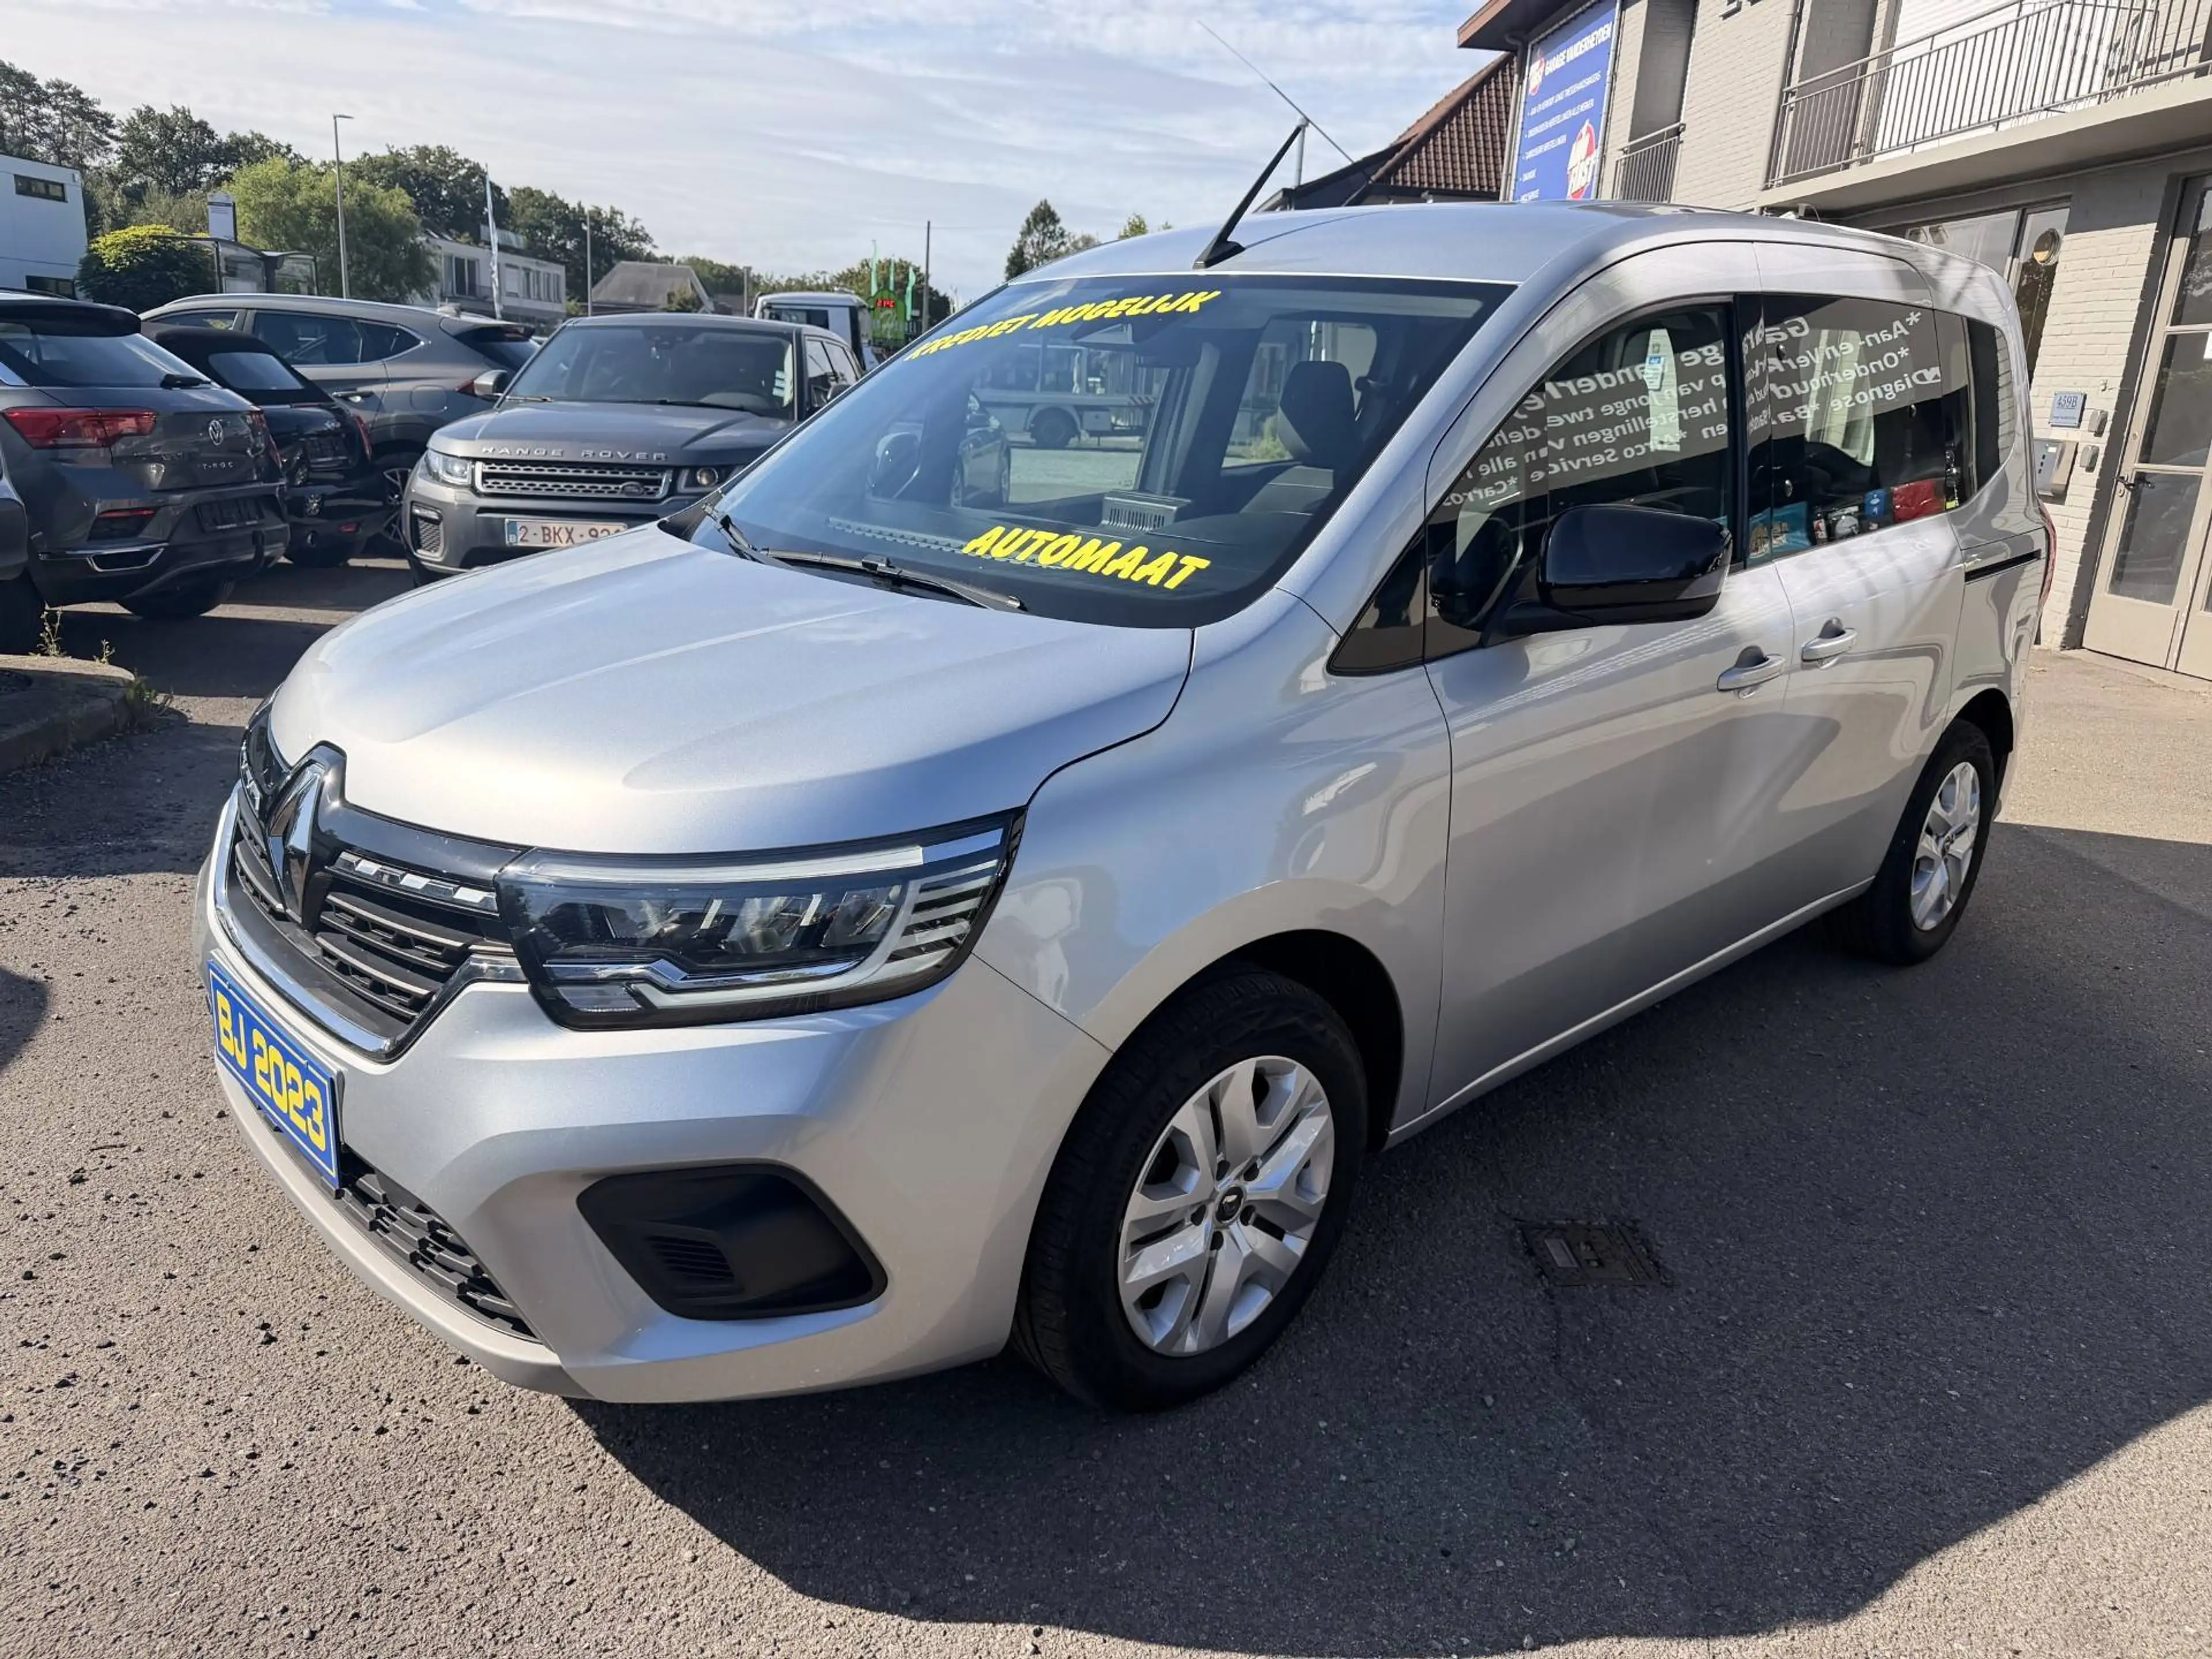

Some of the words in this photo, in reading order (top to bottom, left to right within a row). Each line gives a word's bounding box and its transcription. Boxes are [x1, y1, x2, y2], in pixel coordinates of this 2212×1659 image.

[1029, 291, 1221, 330] MOGELIJK
[482, 447, 565, 457] RANGE
[580, 450, 669, 461] ROVER
[961, 525, 1211, 590] AUTOMAAT
[217, 990, 247, 1070] BJ
[252, 1028, 326, 1152] 2023
